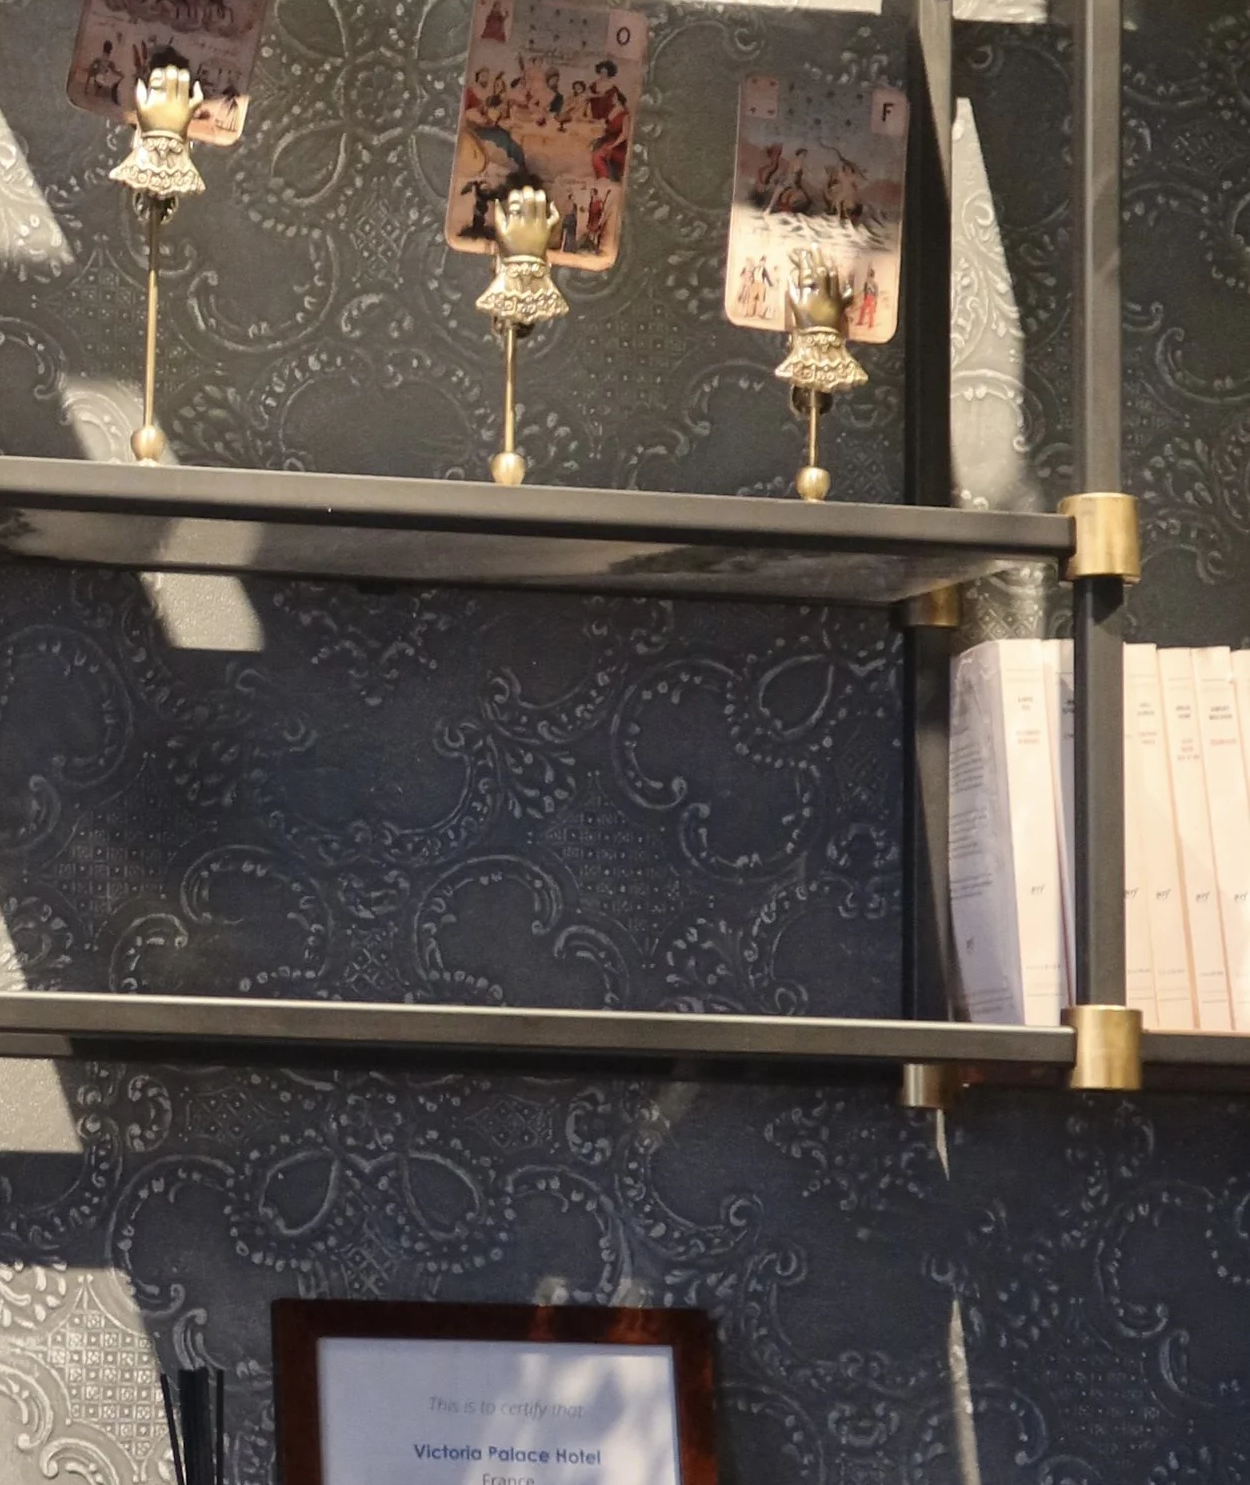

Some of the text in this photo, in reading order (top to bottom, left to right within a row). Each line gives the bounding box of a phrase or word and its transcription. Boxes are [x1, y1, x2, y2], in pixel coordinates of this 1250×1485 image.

[880, 103, 894, 122] F
[430, 1396, 583, 1420] This is to certify that
[414, 1443, 601, 1465] Victoria Palace Hotel
